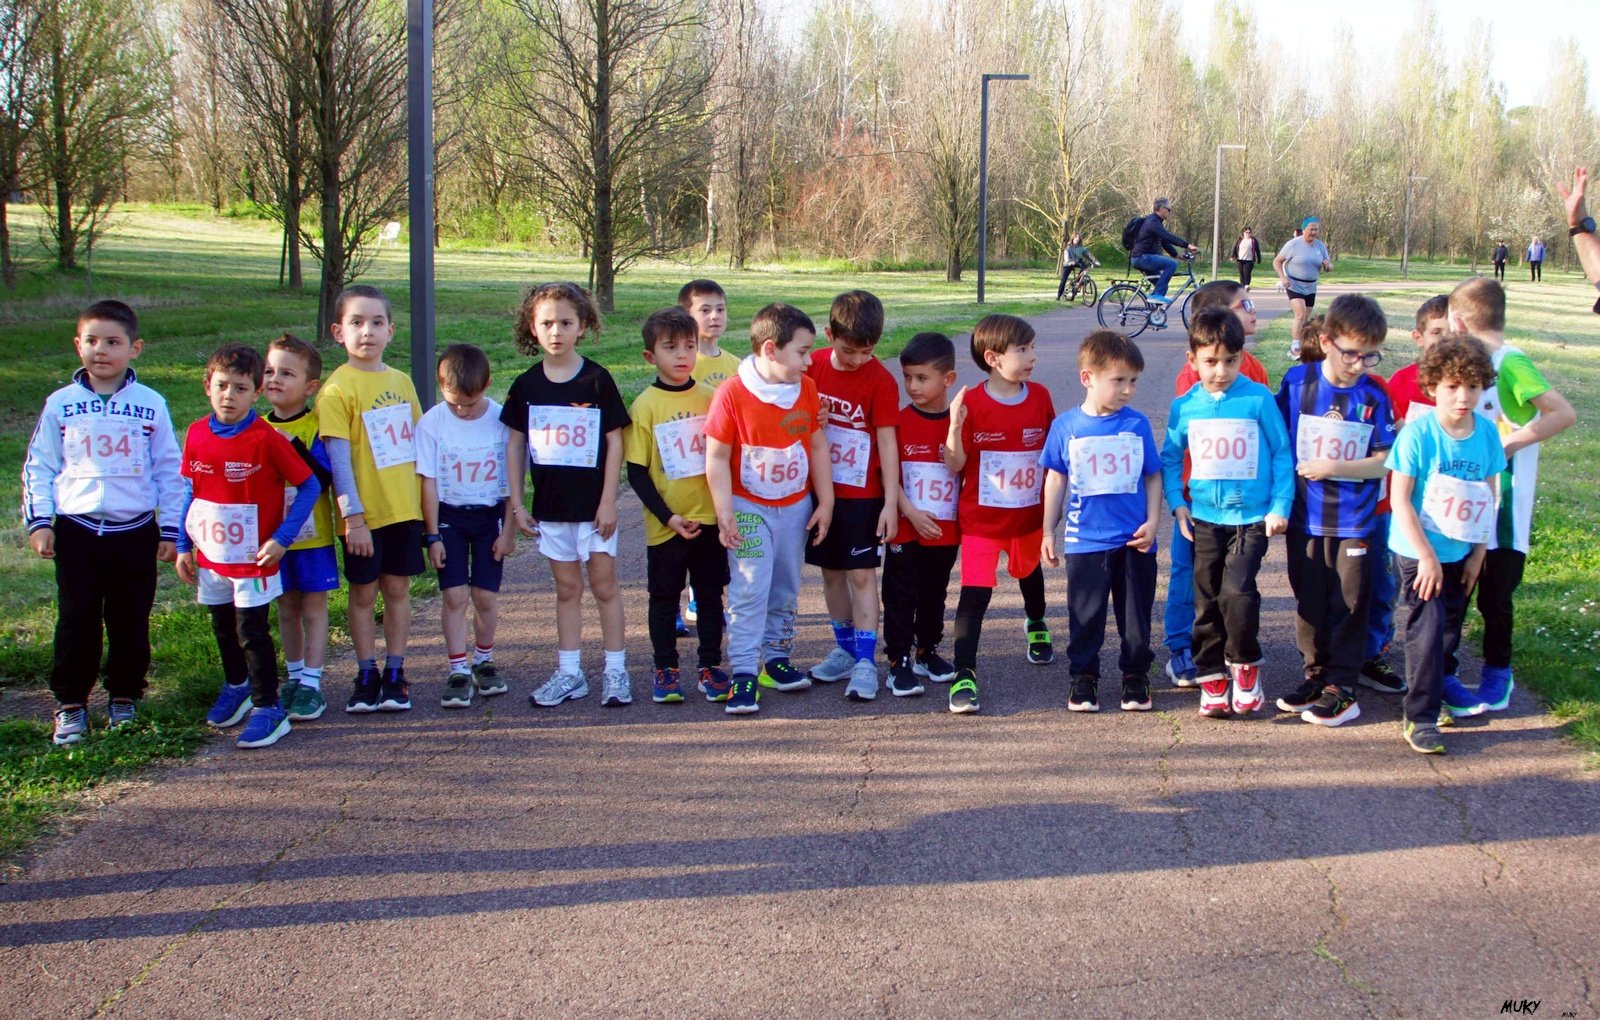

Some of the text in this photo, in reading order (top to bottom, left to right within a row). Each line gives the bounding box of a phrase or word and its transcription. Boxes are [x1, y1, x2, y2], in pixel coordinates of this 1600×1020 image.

[62, 400, 156, 421] ENGLAND
[384, 421, 413, 446] 14
[541, 423, 587, 448] 168
[80, 434, 131, 458] 134
[673, 434, 707, 459] 14
[829, 443, 856, 468] 54
[1201, 437, 1247, 460] 200
[1312, 435, 1357, 462] 130
[452, 459, 497, 483] 172
[756, 461, 799, 484] 156
[1087, 453, 1131, 476] 131
[994, 467, 1036, 490] 148
[914, 479, 954, 503] 152
[734, 511, 764, 524] CHECK
[1442, 496, 1487, 524] 167
[198, 519, 244, 545] 169
[735, 549, 764, 558] KINGDOM
[1034, 633, 1046, 641] NIKE
